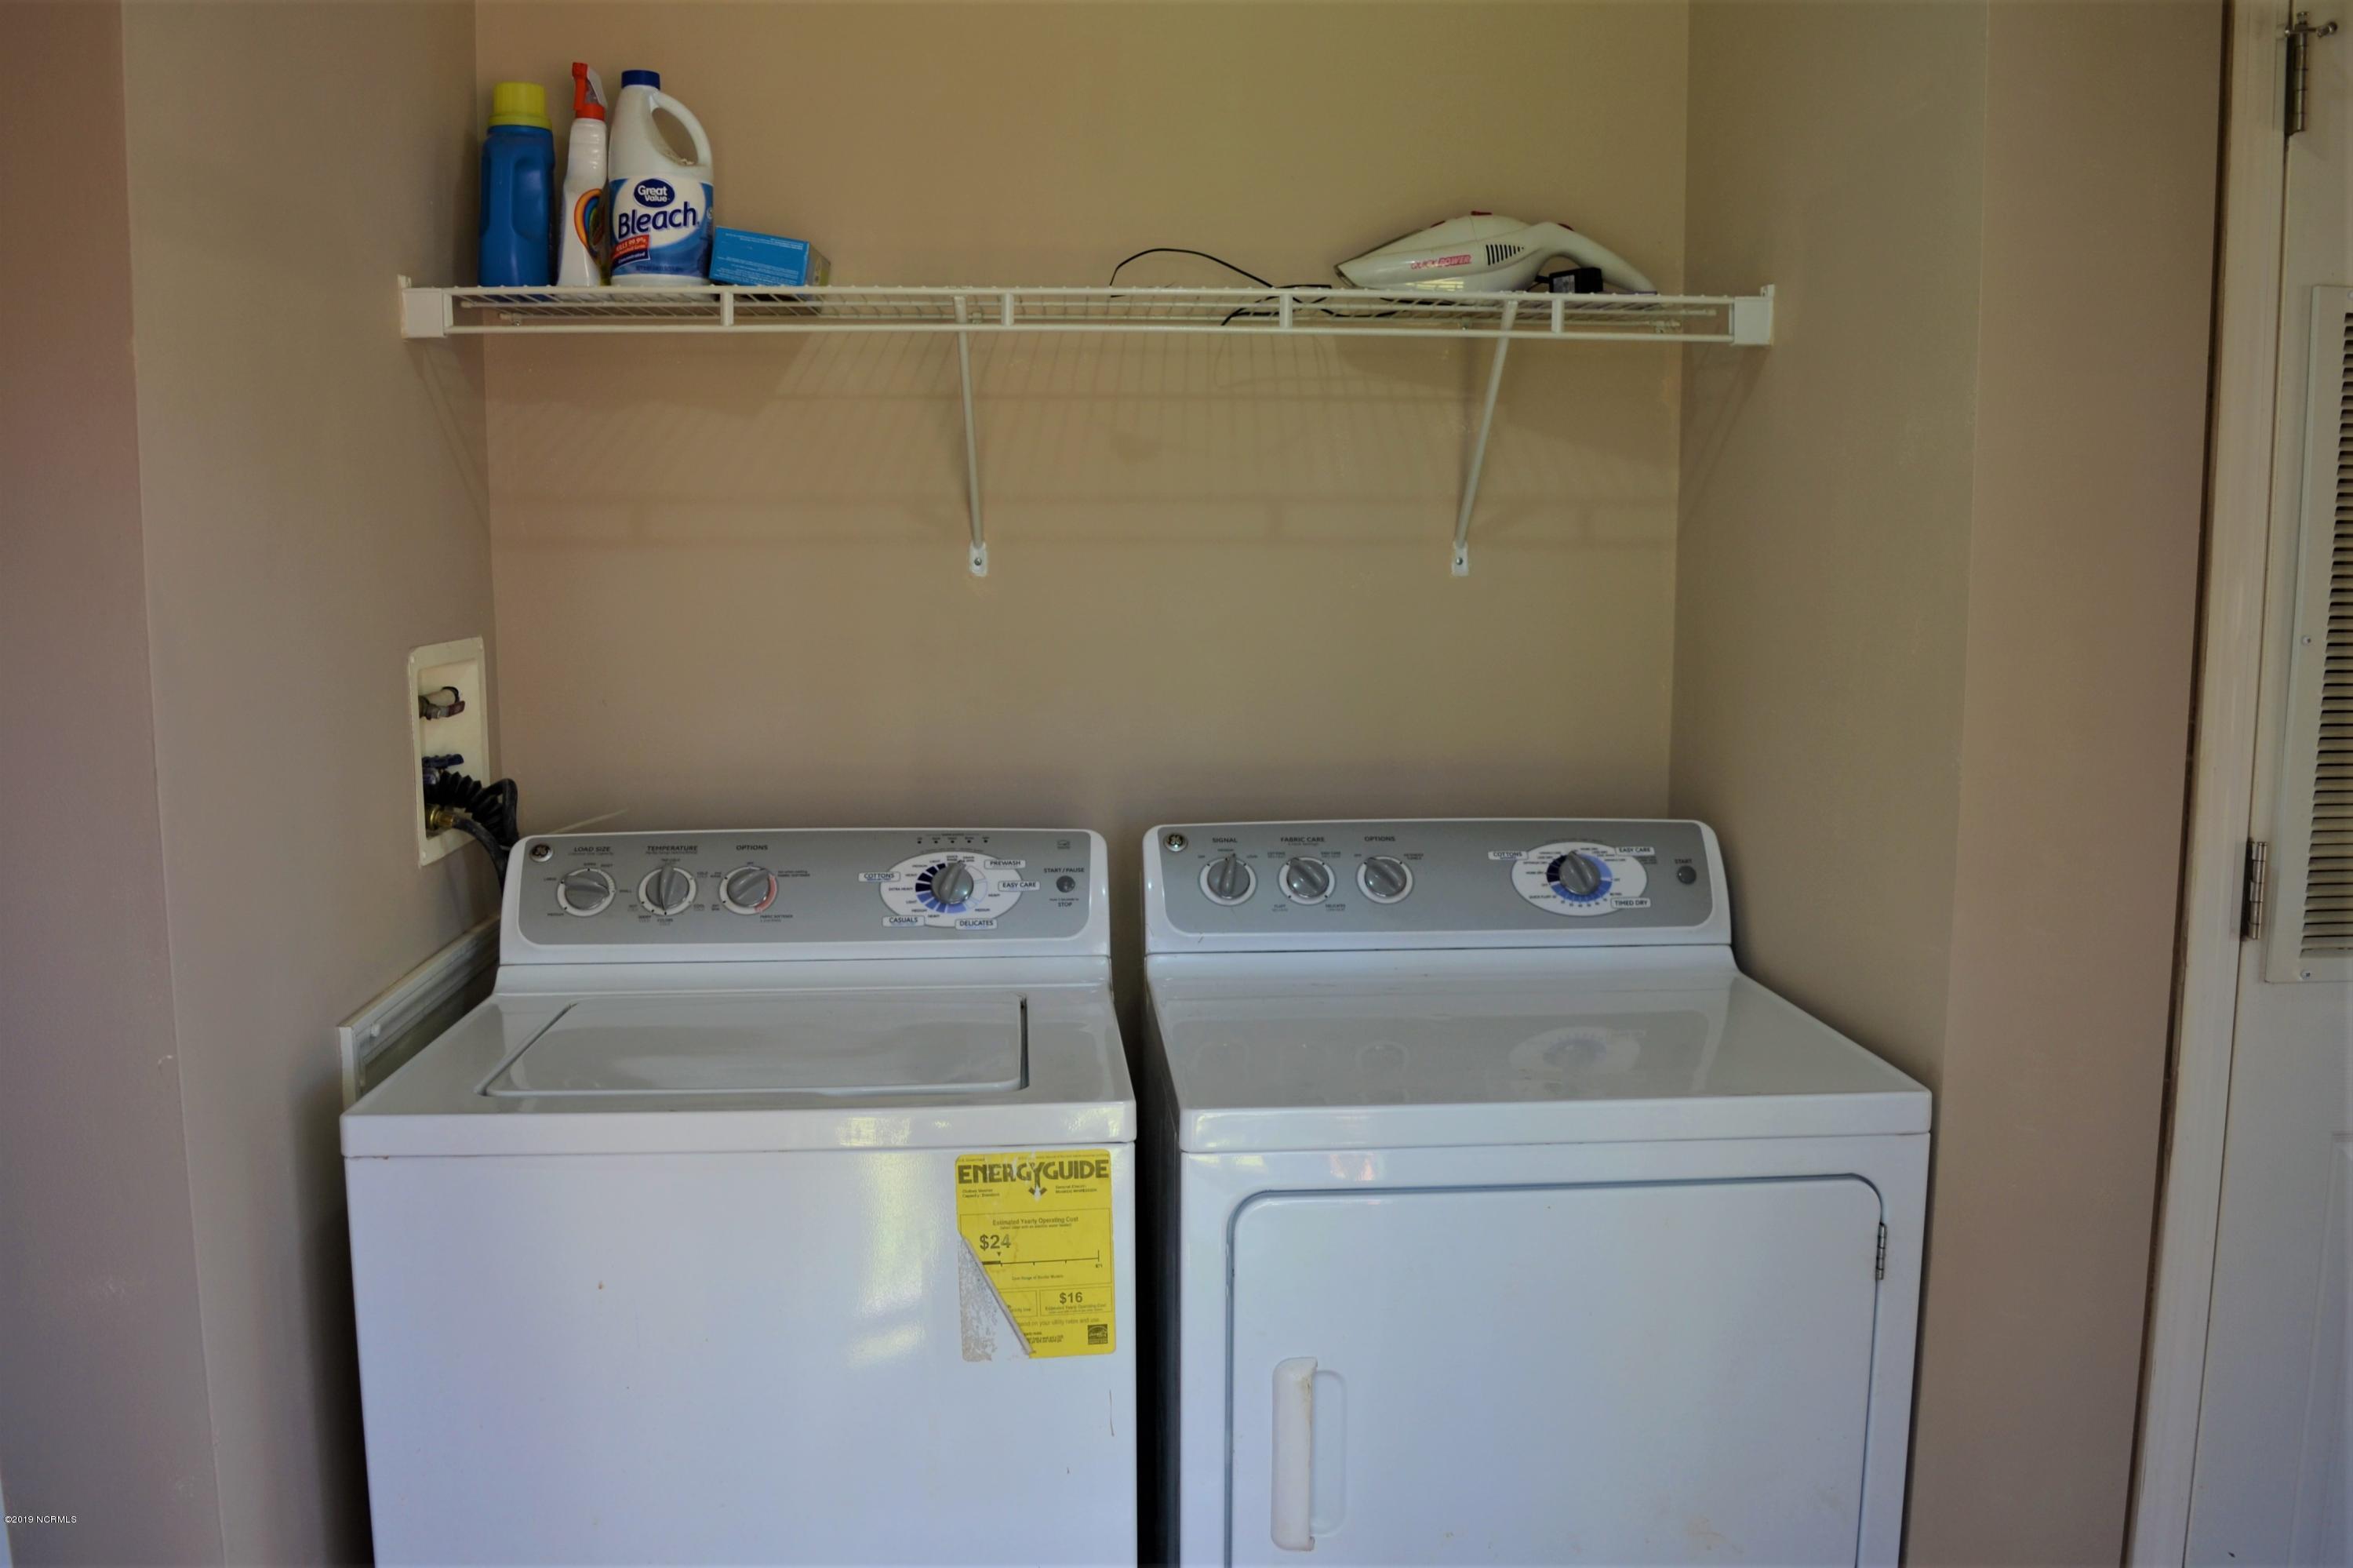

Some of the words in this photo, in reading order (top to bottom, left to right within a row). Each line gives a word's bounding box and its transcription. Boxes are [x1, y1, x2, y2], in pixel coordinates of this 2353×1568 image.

[638, 185, 667, 196] Great
[618, 201, 697, 239] Bleach
[1438, 255, 1471, 267] POWER
[958, 1159, 1110, 1187] ENERGYGUIDE
[980, 1234, 1011, 1251] $24
[1060, 1291, 1082, 1304] $16
